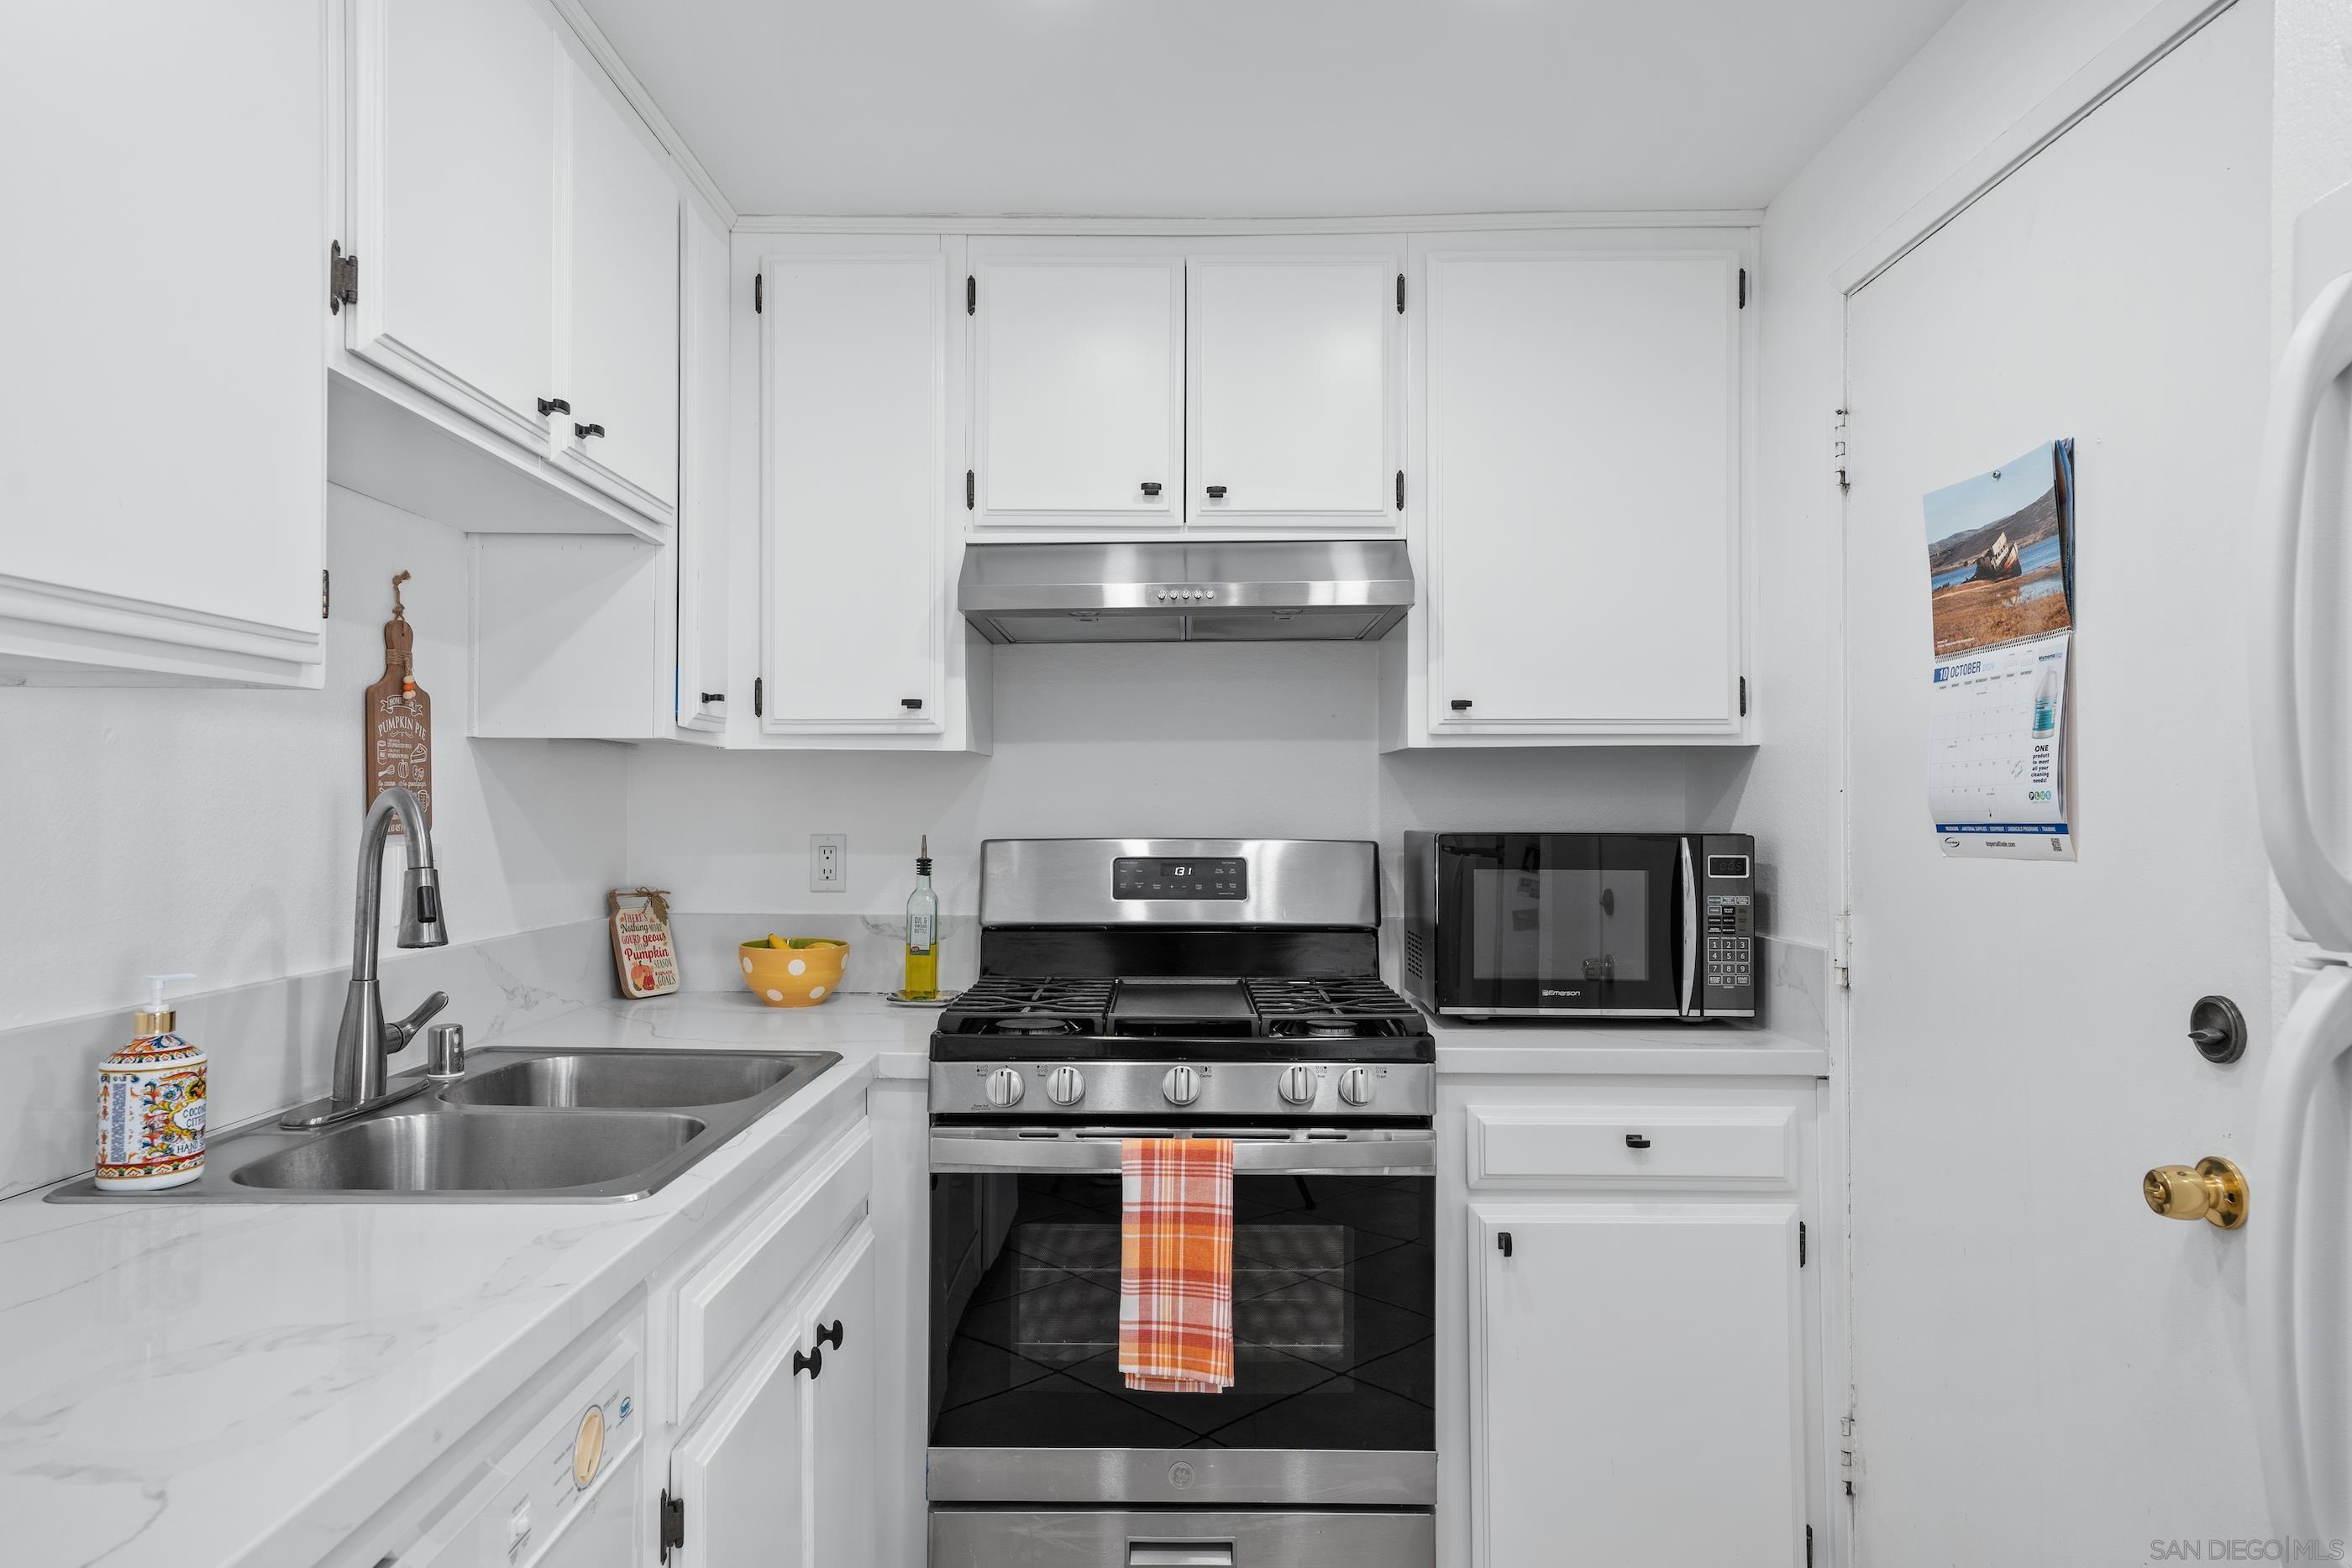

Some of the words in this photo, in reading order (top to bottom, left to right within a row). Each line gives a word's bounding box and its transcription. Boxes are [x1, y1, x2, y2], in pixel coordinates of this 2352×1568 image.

[1940, 668, 1949, 681] 10
[1950, 661, 1982, 679] OCTOBER
[377, 716, 414, 737] PUMPKIN
[414, 721, 427, 741] PIE
[2034, 744, 2049, 753] ONE
[621, 924, 648, 934] Nothing
[624, 945, 669, 962] Pumpkin
